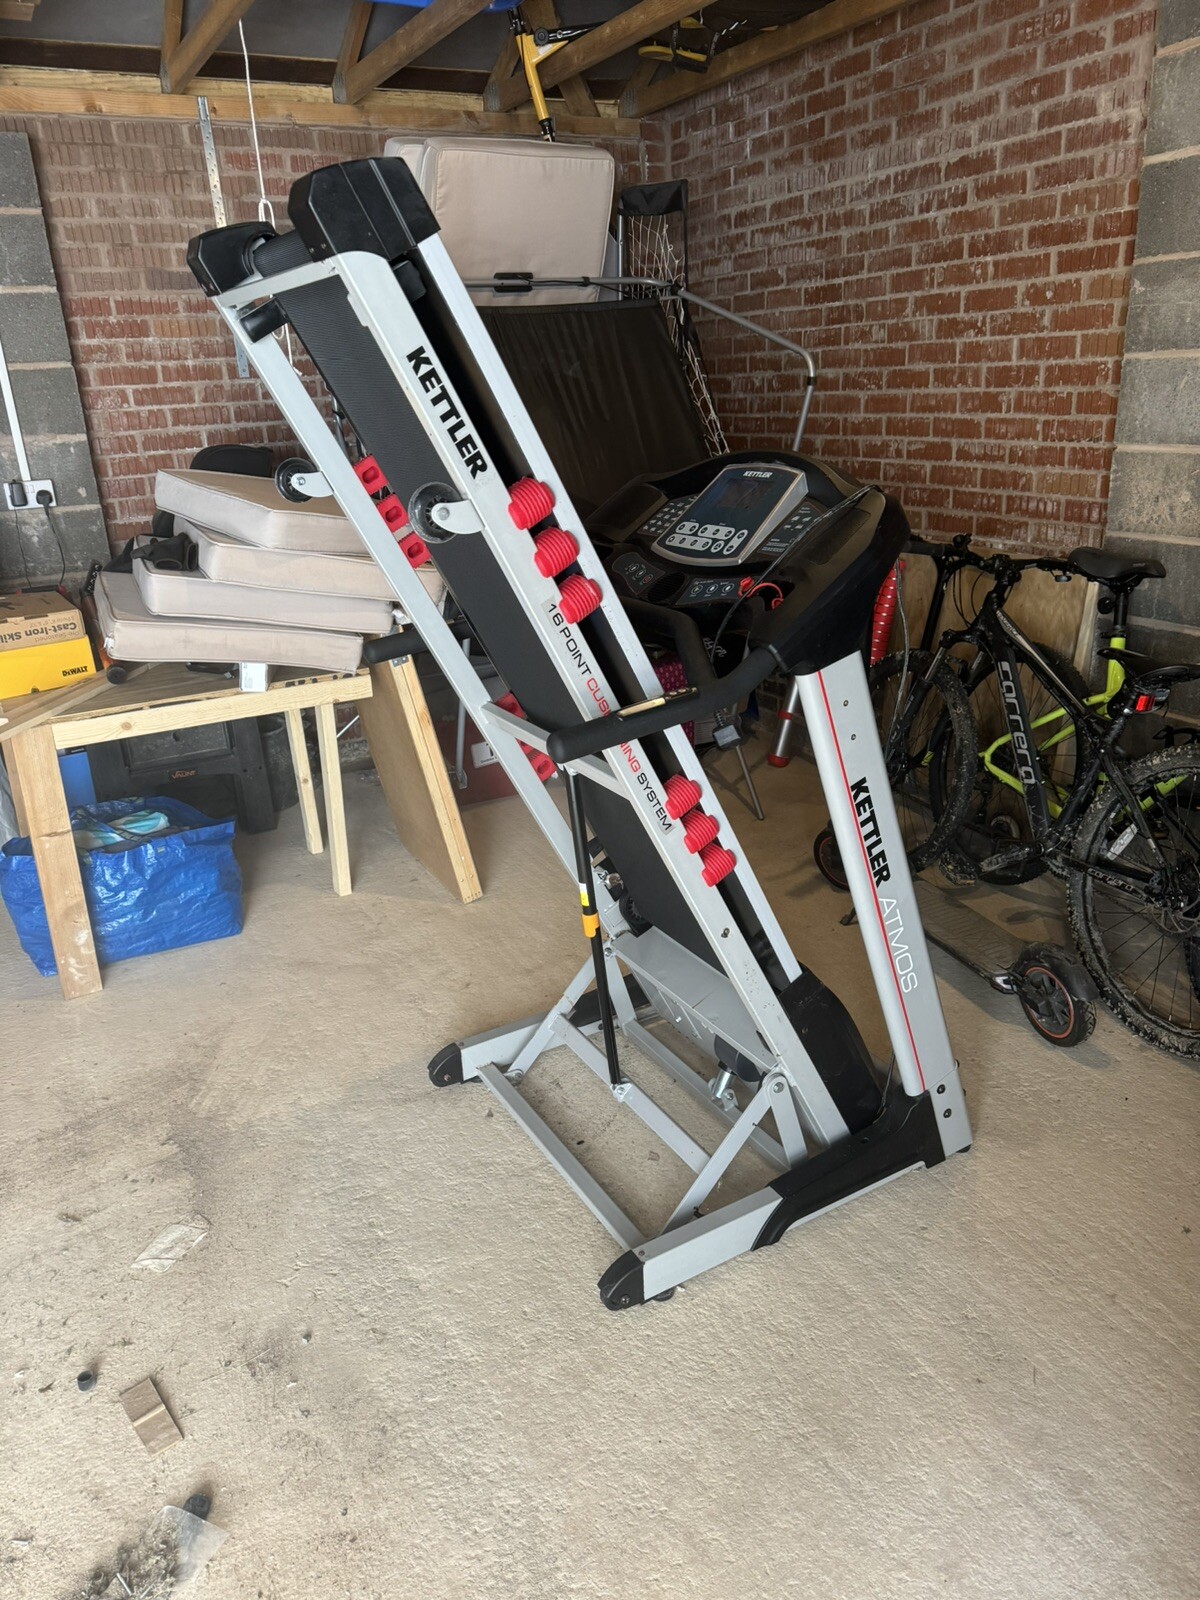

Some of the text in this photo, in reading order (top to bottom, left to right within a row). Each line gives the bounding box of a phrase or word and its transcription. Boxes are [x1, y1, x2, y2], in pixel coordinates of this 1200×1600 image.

[406, 345, 488, 480] KETTLER
[742, 470, 773, 478] KETTLER
[25, 622, 77, 638] Cast-Iron
[548, 603, 564, 627] 16
[560, 626, 592, 675] POINT
[637, 772, 673, 832] SYSTEM
[998, 661, 1036, 785] carrera
[850, 776, 918, 993] KETTLER ATMOS
